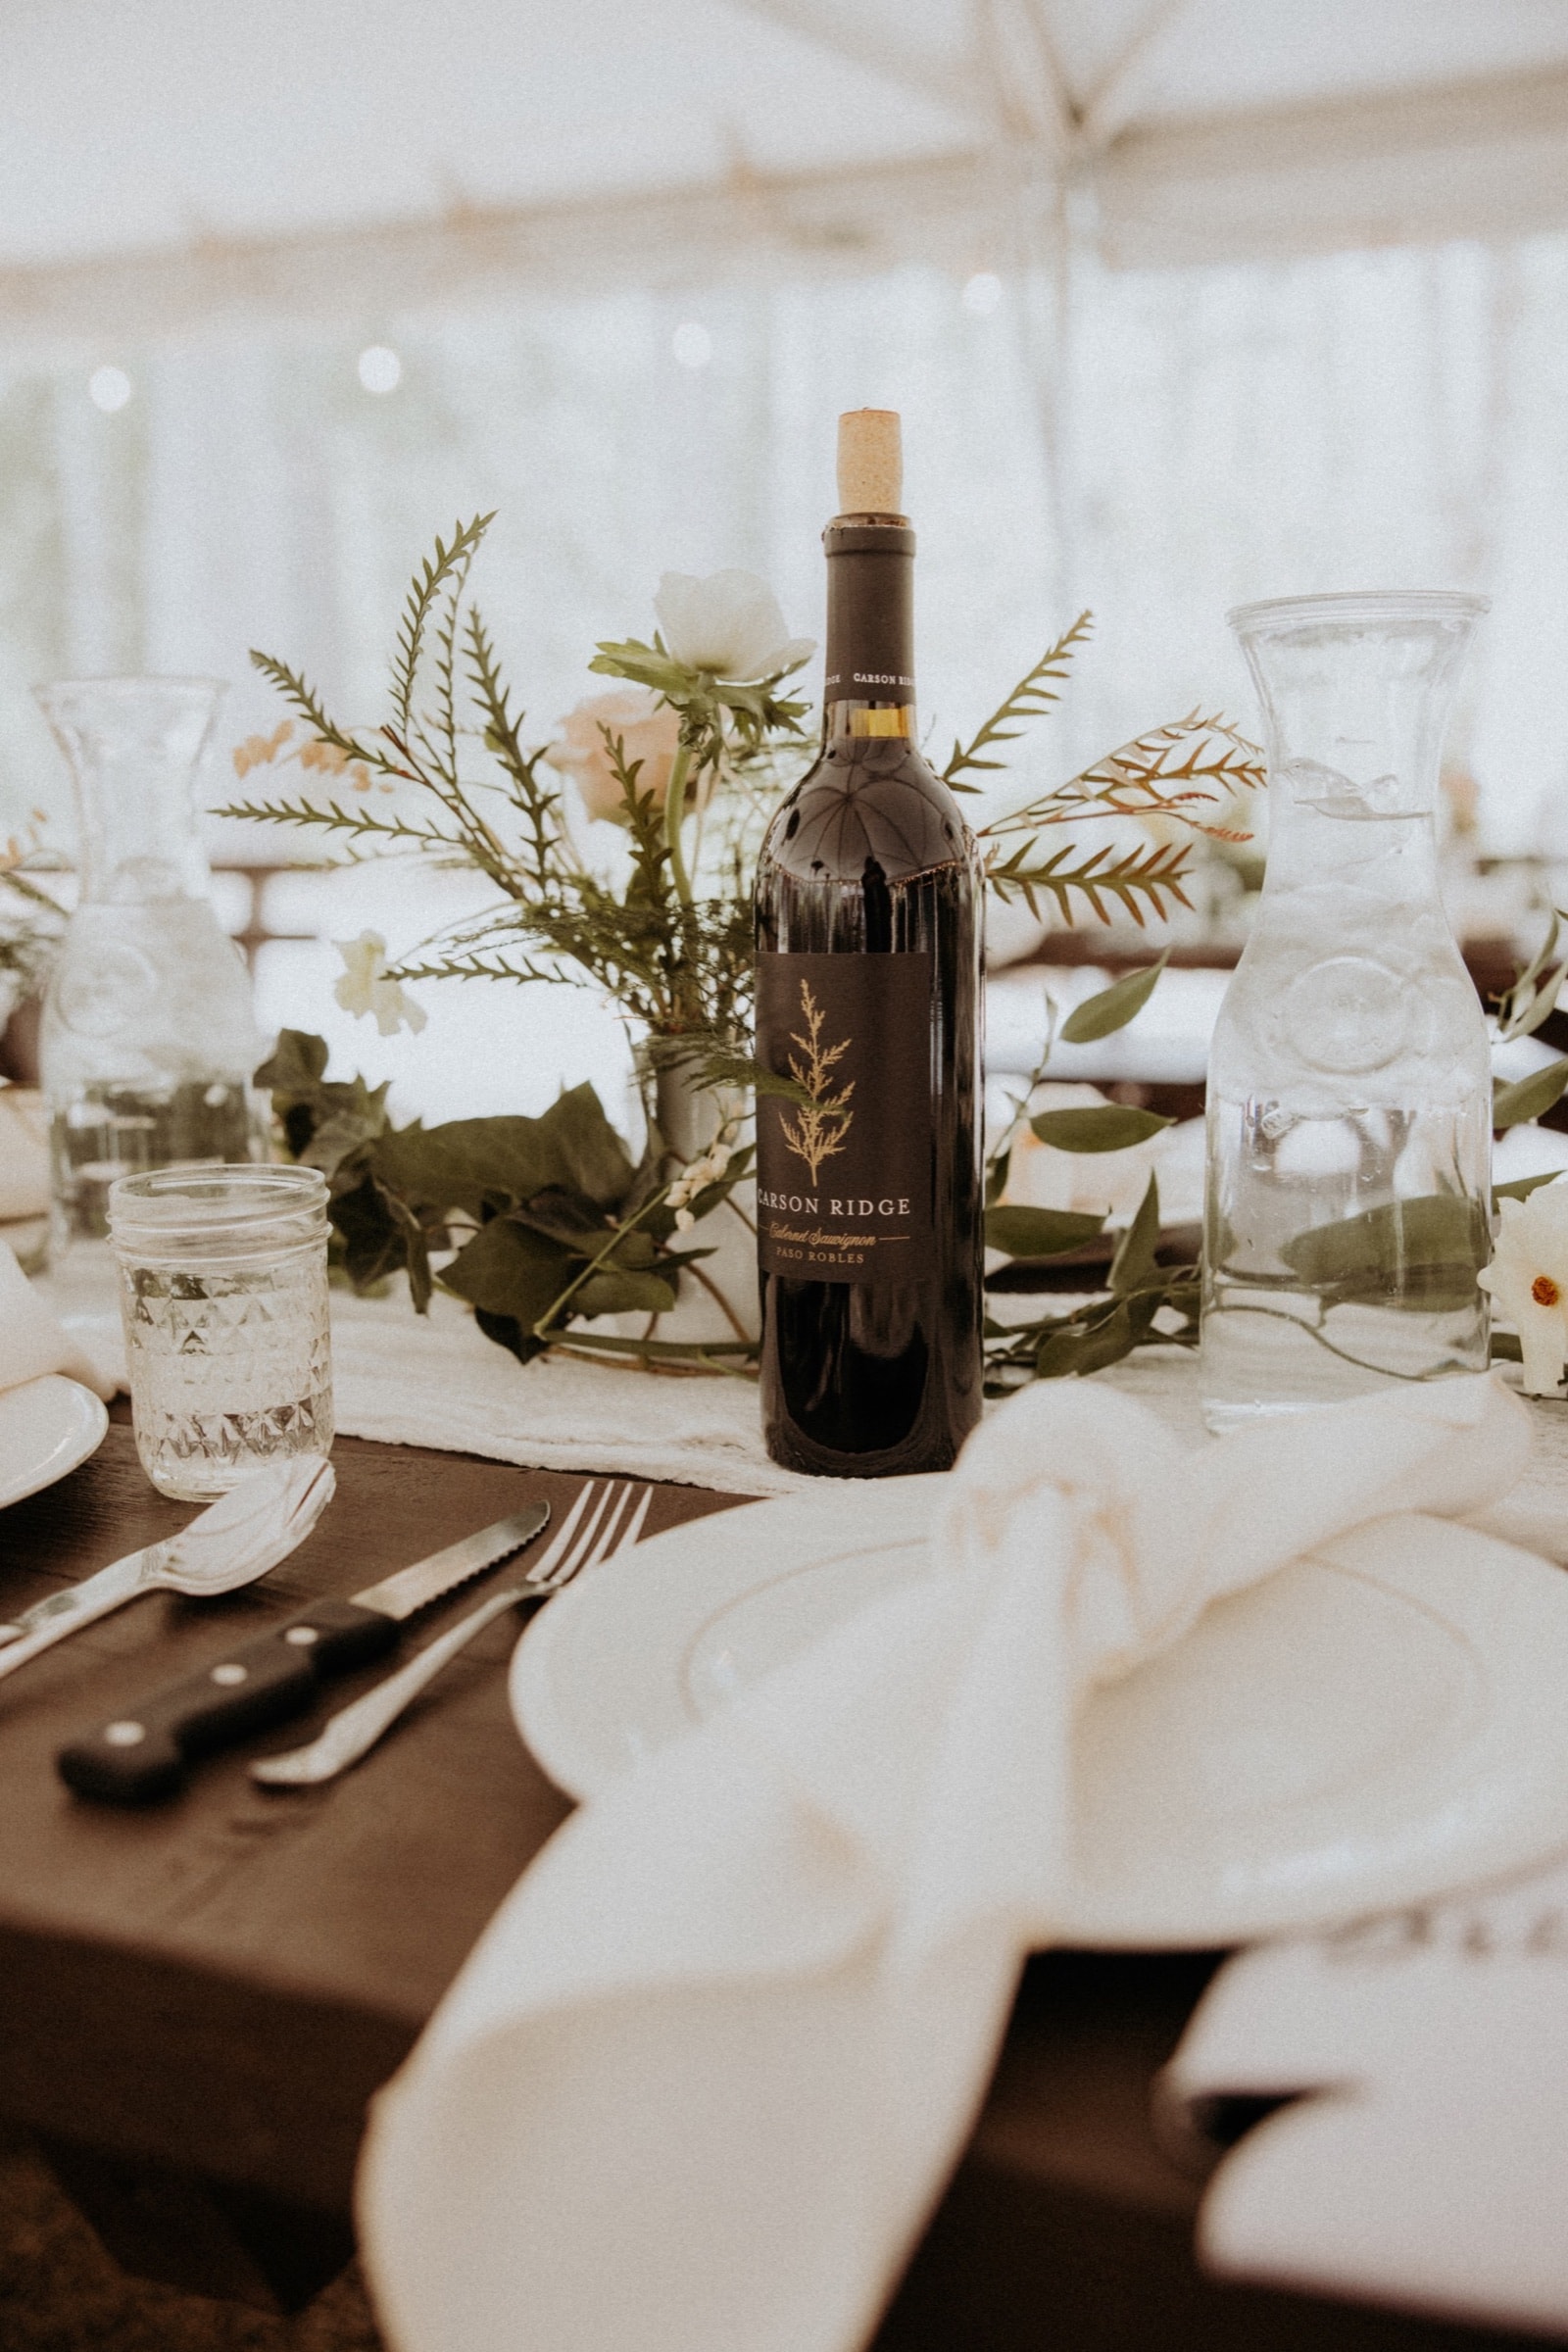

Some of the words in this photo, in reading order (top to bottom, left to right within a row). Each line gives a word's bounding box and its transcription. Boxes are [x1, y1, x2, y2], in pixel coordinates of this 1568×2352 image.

[853, 672, 896, 685] CARSON
[758, 1188, 819, 1214] CARSON
[830, 1199, 910, 1216] RIDGE
[769, 1221, 808, 1242] Cabernet
[808, 1227, 876, 1250] Sauvignon
[776, 1247, 804, 1260] PASO
[808, 1251, 864, 1264] ROBLES
